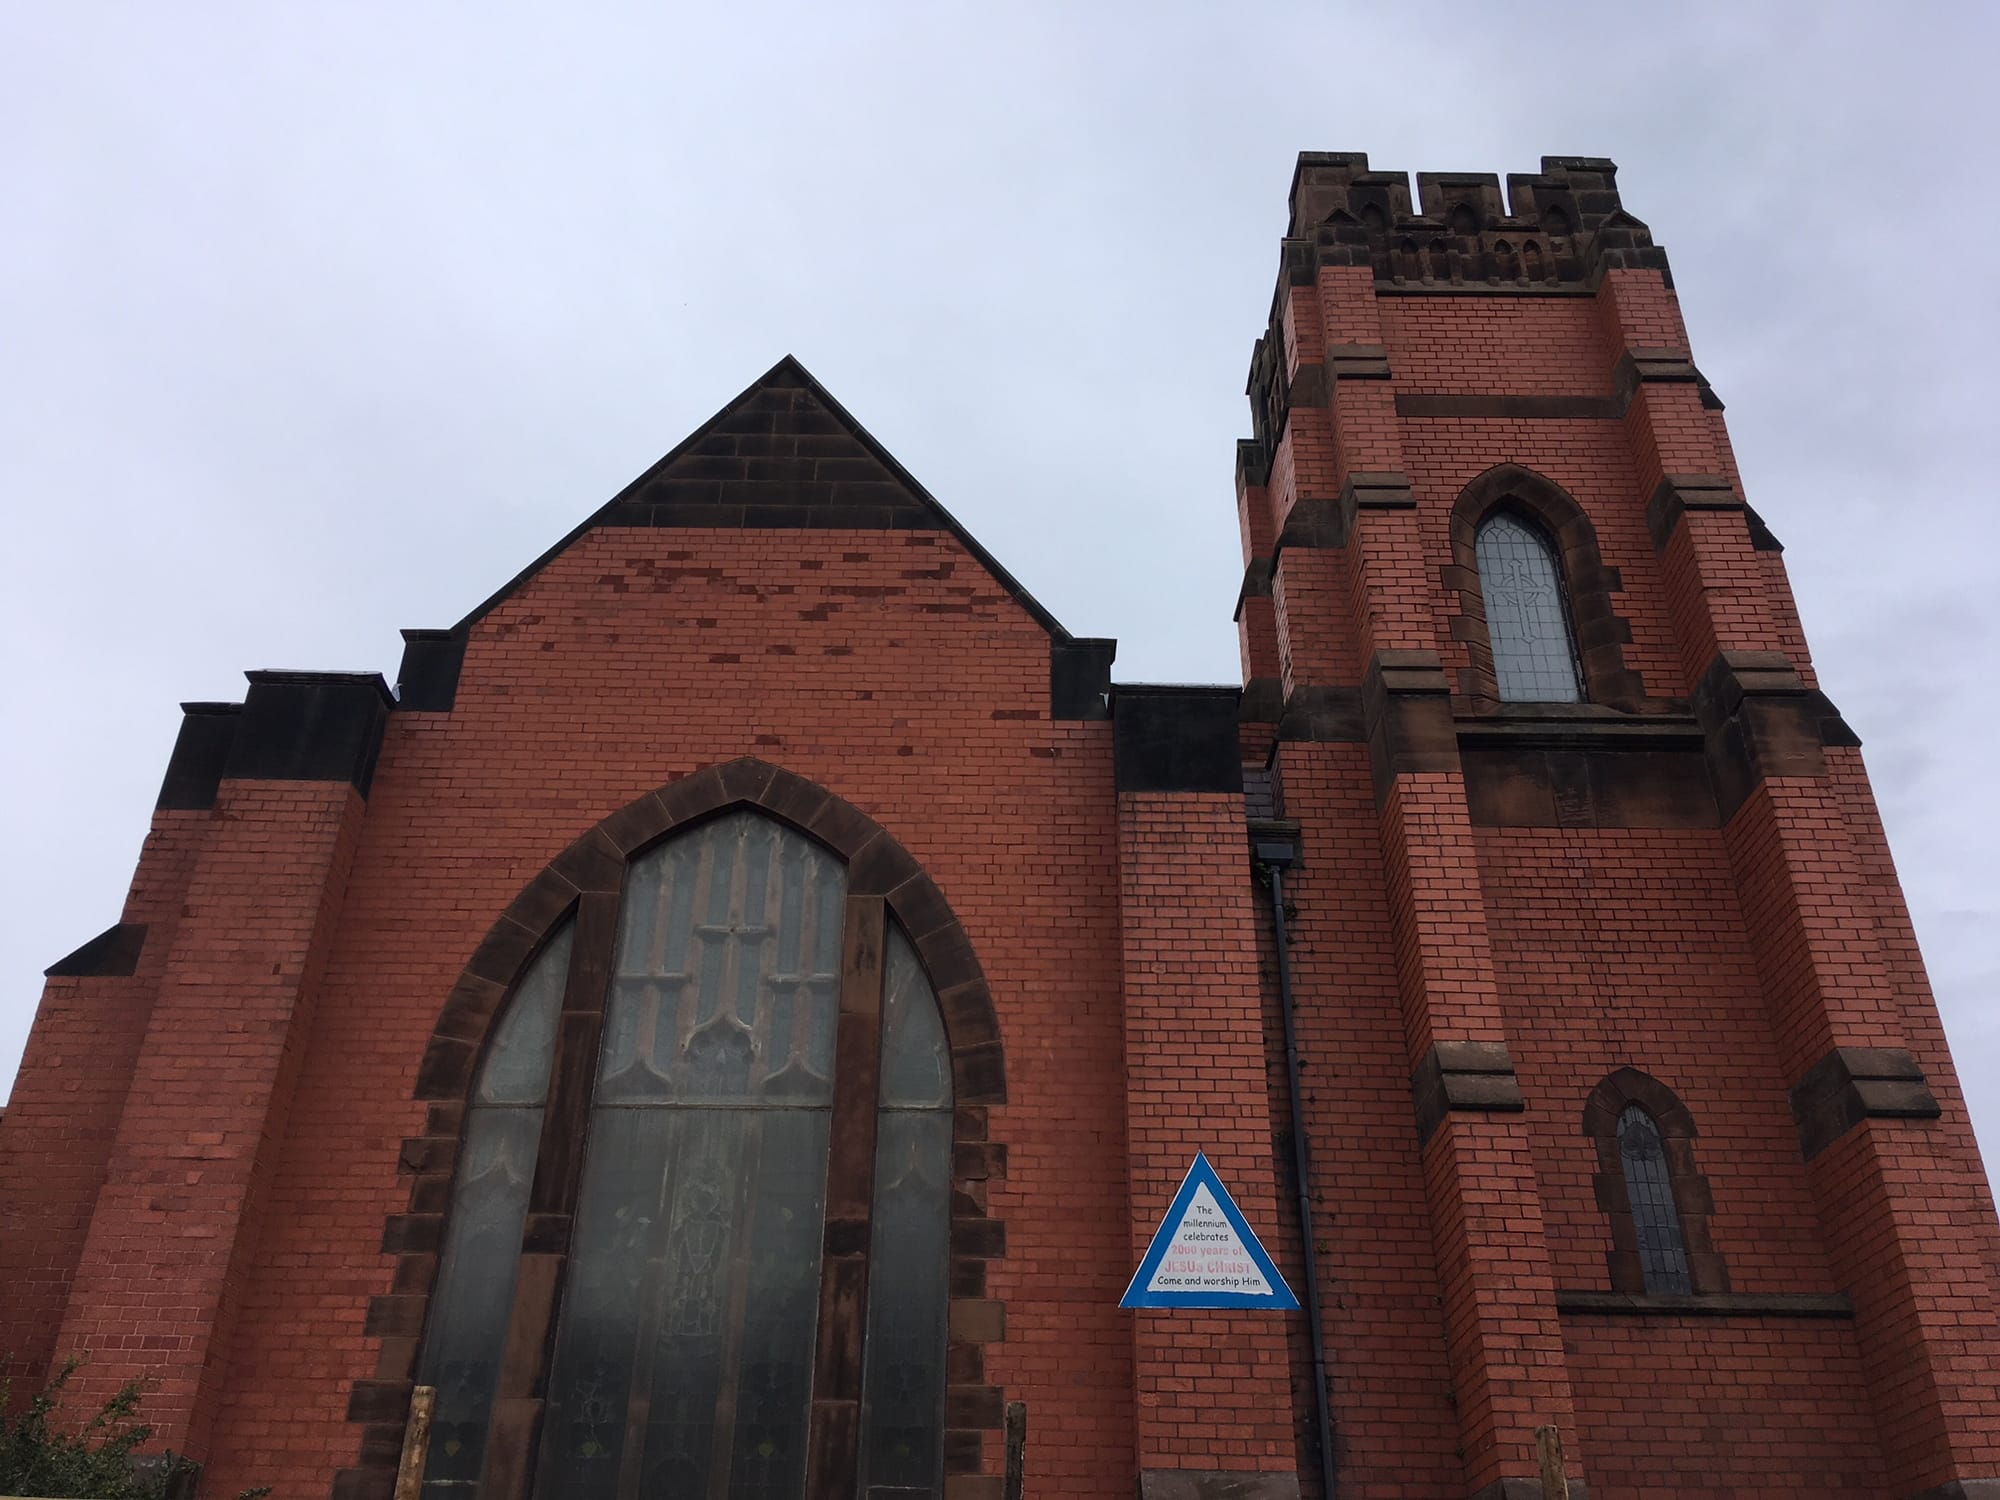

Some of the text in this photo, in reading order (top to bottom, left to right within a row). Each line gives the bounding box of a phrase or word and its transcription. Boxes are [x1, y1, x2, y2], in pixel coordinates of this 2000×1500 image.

[1196, 1206, 1213, 1215] The
[1183, 1219, 1227, 1228] millennium
[1183, 1233, 1229, 1241] celebrates
[1232, 1245, 1243, 1255] of
[1157, 1276, 1261, 1288] Come and worship Him
